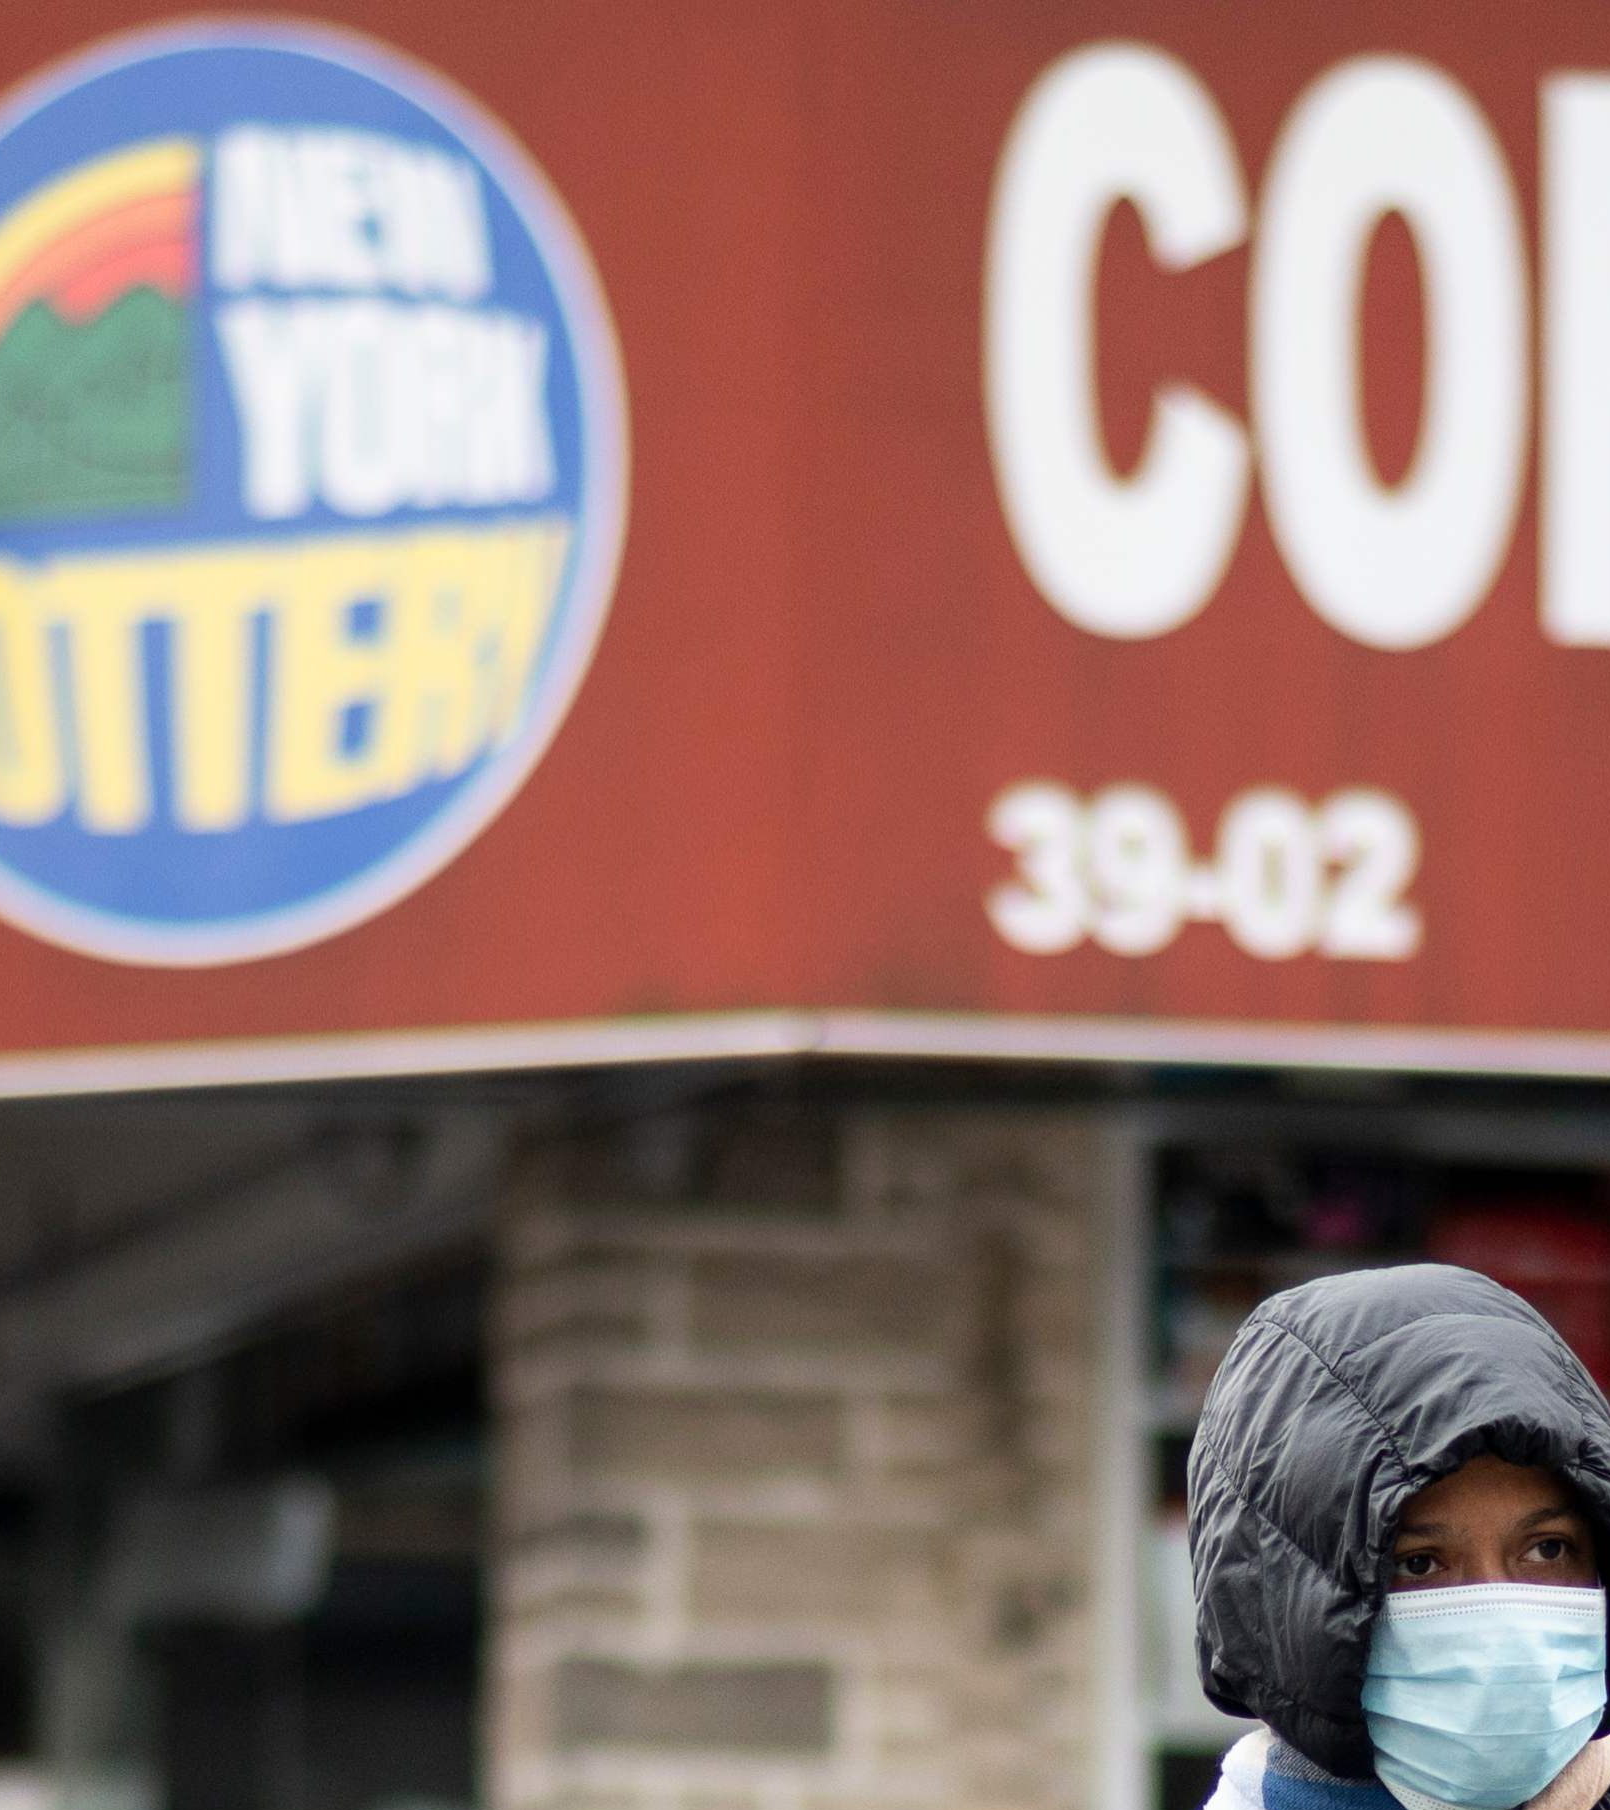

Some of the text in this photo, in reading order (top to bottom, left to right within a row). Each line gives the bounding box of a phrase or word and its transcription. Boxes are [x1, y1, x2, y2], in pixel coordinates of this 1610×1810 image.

[211, 121, 496, 303] NEW
[210, 296, 558, 521] YORK
[987, 776, 1423, 964] 39-02
